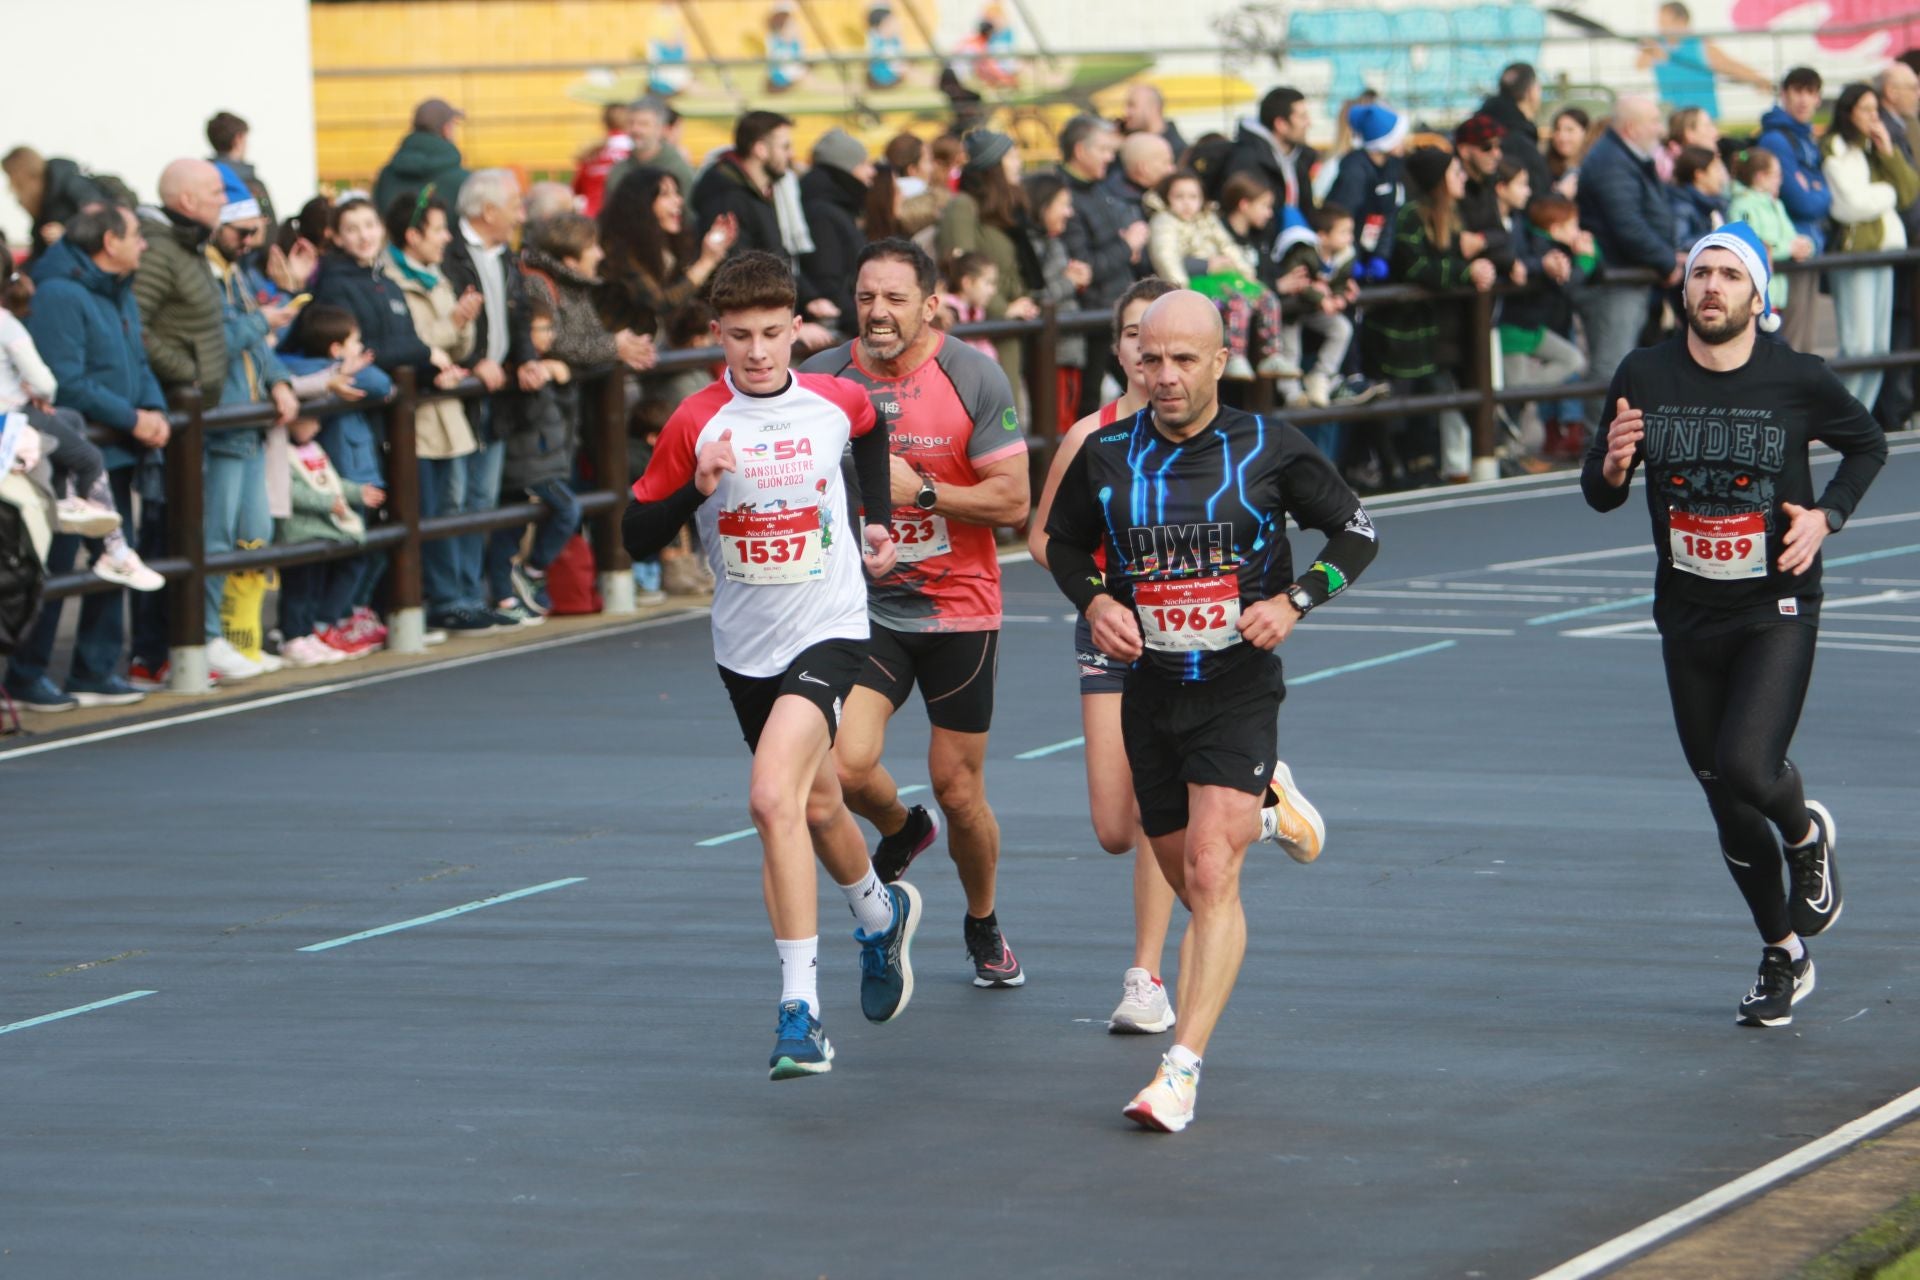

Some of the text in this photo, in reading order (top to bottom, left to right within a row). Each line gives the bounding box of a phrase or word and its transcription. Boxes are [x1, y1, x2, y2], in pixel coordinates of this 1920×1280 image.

[1657, 405, 1772, 419] RUN LIKE AN ANIMAL
[774, 437, 812, 461] 54
[1645, 414, 1785, 473] UNDER
[744, 459, 814, 479] SANSILVESTRE
[784, 474, 804, 486] 2023
[749, 515, 777, 523] Carrera
[778, 511, 804, 521] Popular
[745, 528, 794, 537] Nochebuena
[889, 520, 935, 544] 623
[734, 536, 807, 564] 1537
[1128, 523, 1233, 575] PIXEL
[1682, 535, 1753, 561] 1889
[1165, 583, 1194, 591] Carrera
[1163, 597, 1212, 606] Nochebuena
[1151, 604, 1228, 632] 1962
